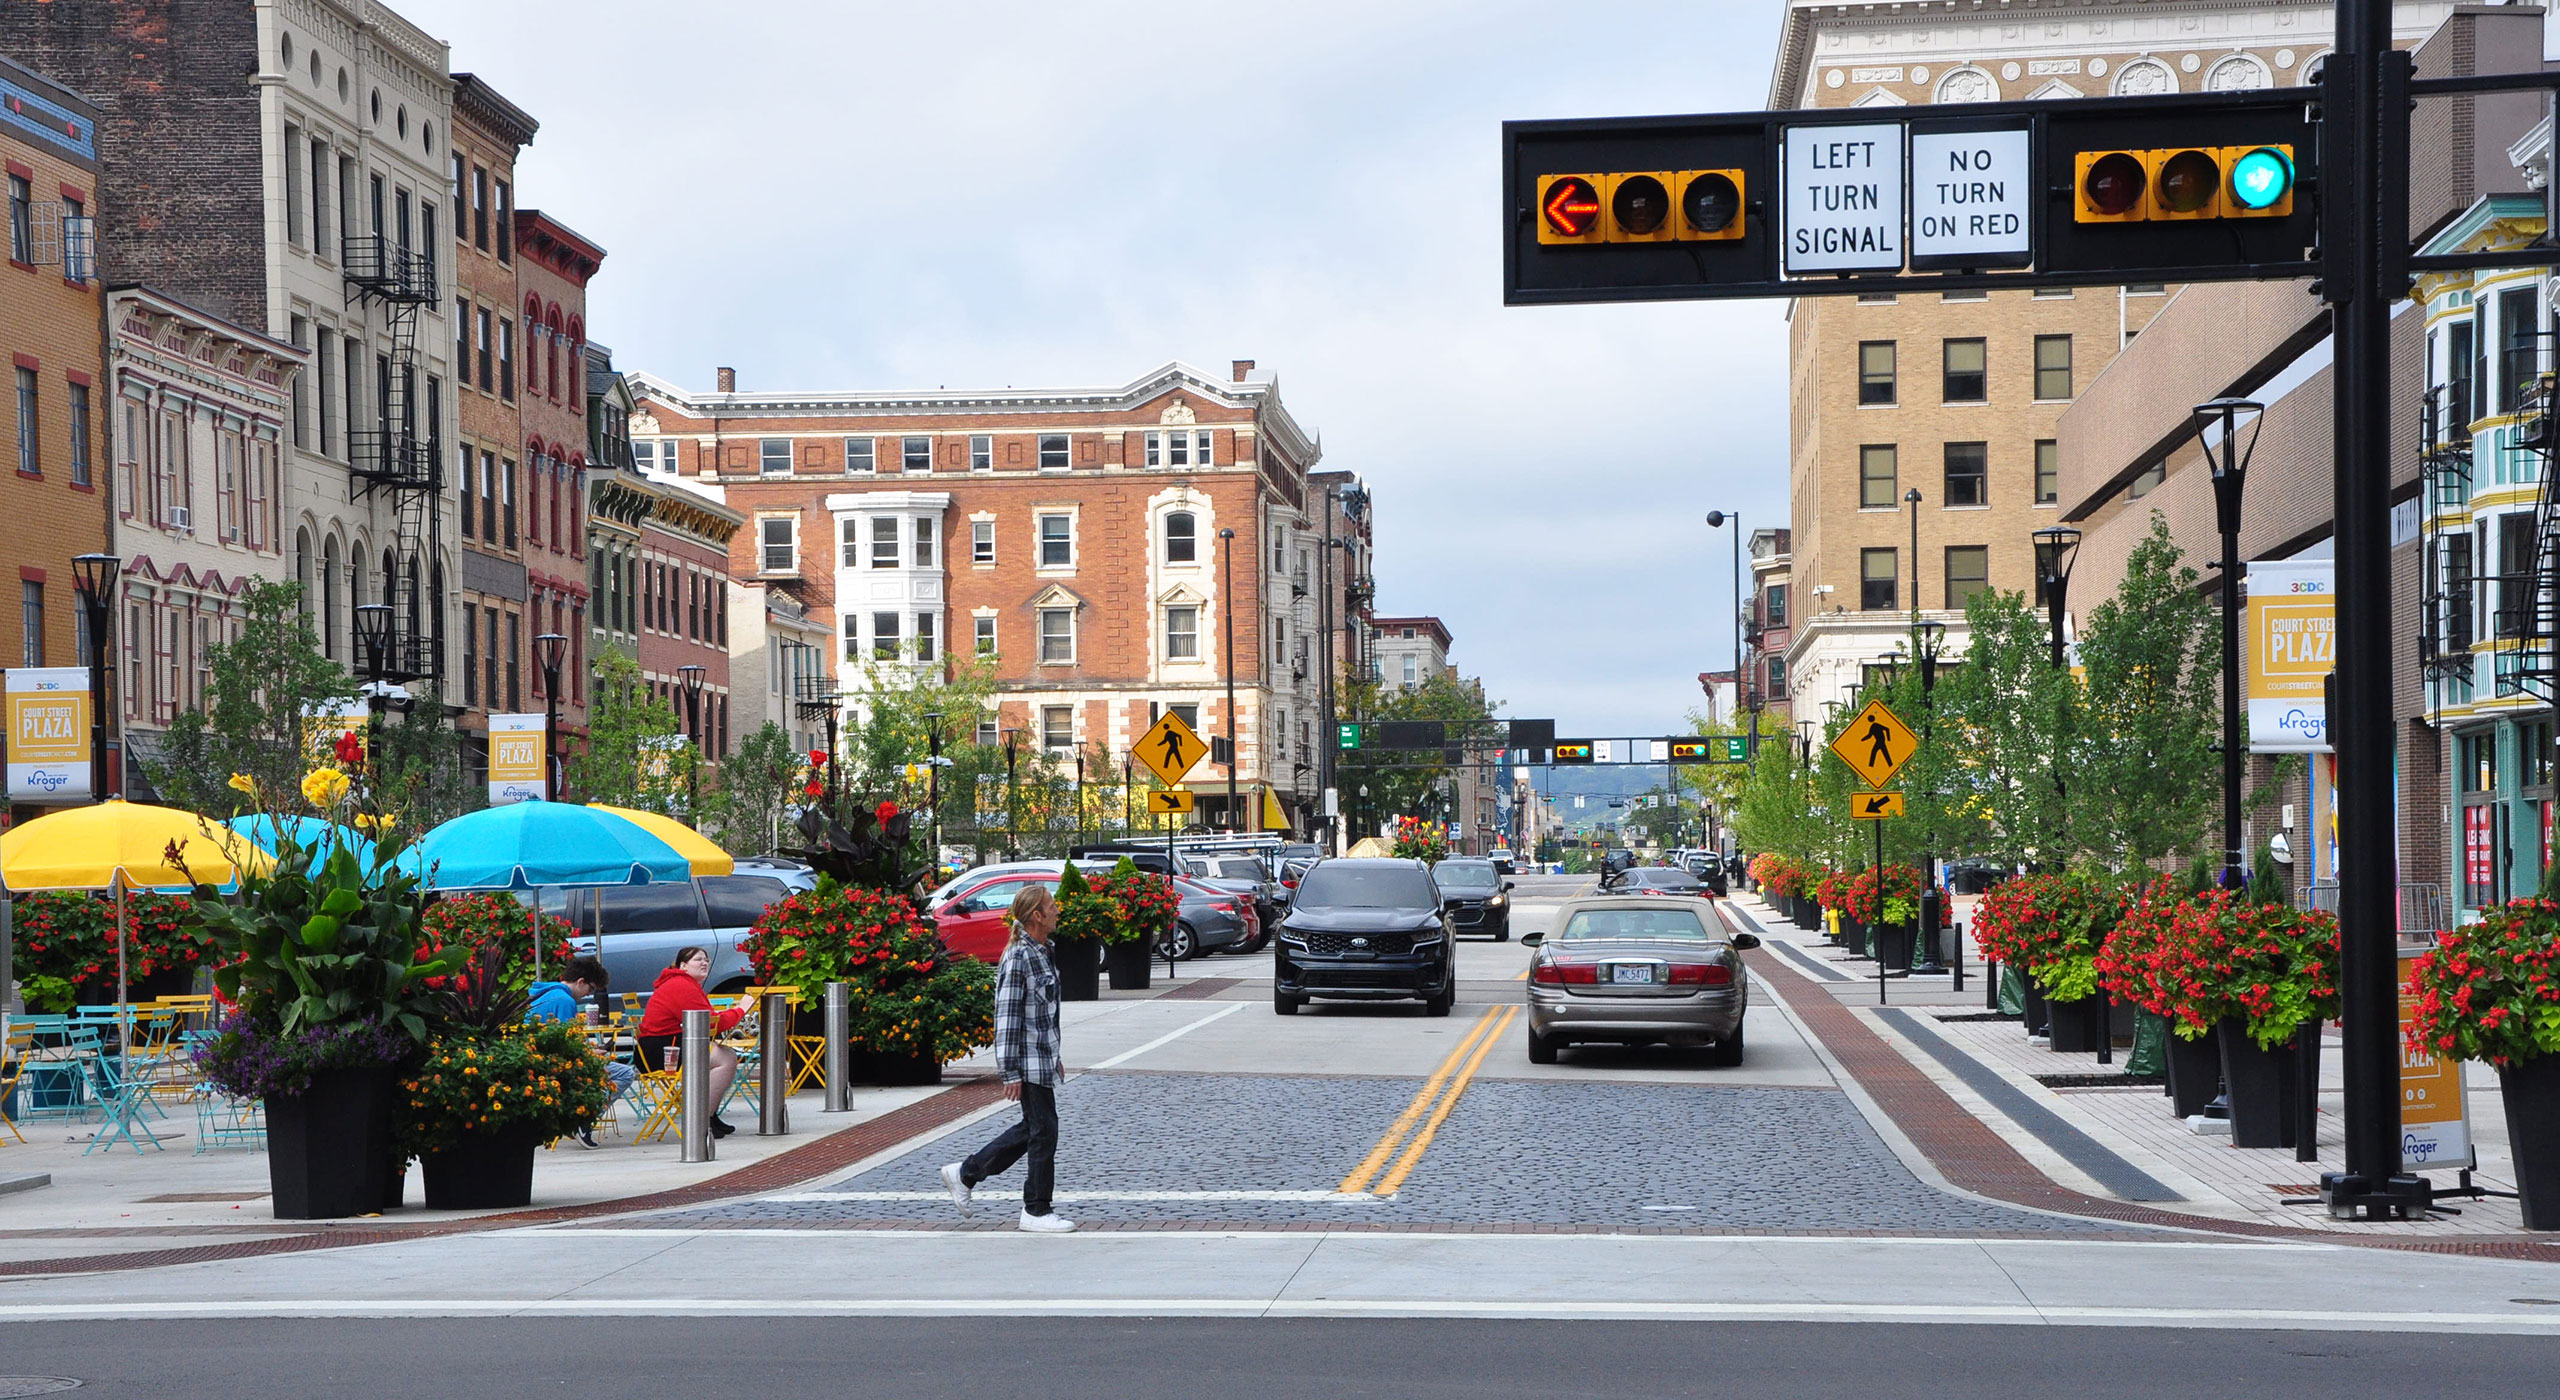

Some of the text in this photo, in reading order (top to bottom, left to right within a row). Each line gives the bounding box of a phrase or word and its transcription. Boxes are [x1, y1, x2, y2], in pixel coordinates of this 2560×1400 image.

[1813, 142, 1875, 169] LEFT
[1951, 150, 1991, 171] NO
[1809, 184, 1877, 211] TURN
[1937, 182, 2003, 204] TURN
[1923, 214, 2019, 237] ON RED
[1796, 226, 1893, 254] SIGNAL
[2291, 582, 2324, 592] 3CDC
[2272, 618, 2304, 633] COURT
[36, 682, 59, 691] 3CDC
[23, 706, 73, 718] COURT STREET
[23, 717, 73, 739] PLAZA
[500, 748, 534, 764] PLAZA
[27, 770, 68, 792] Kroger
[2400, 1044, 2434, 1068] LAZA
